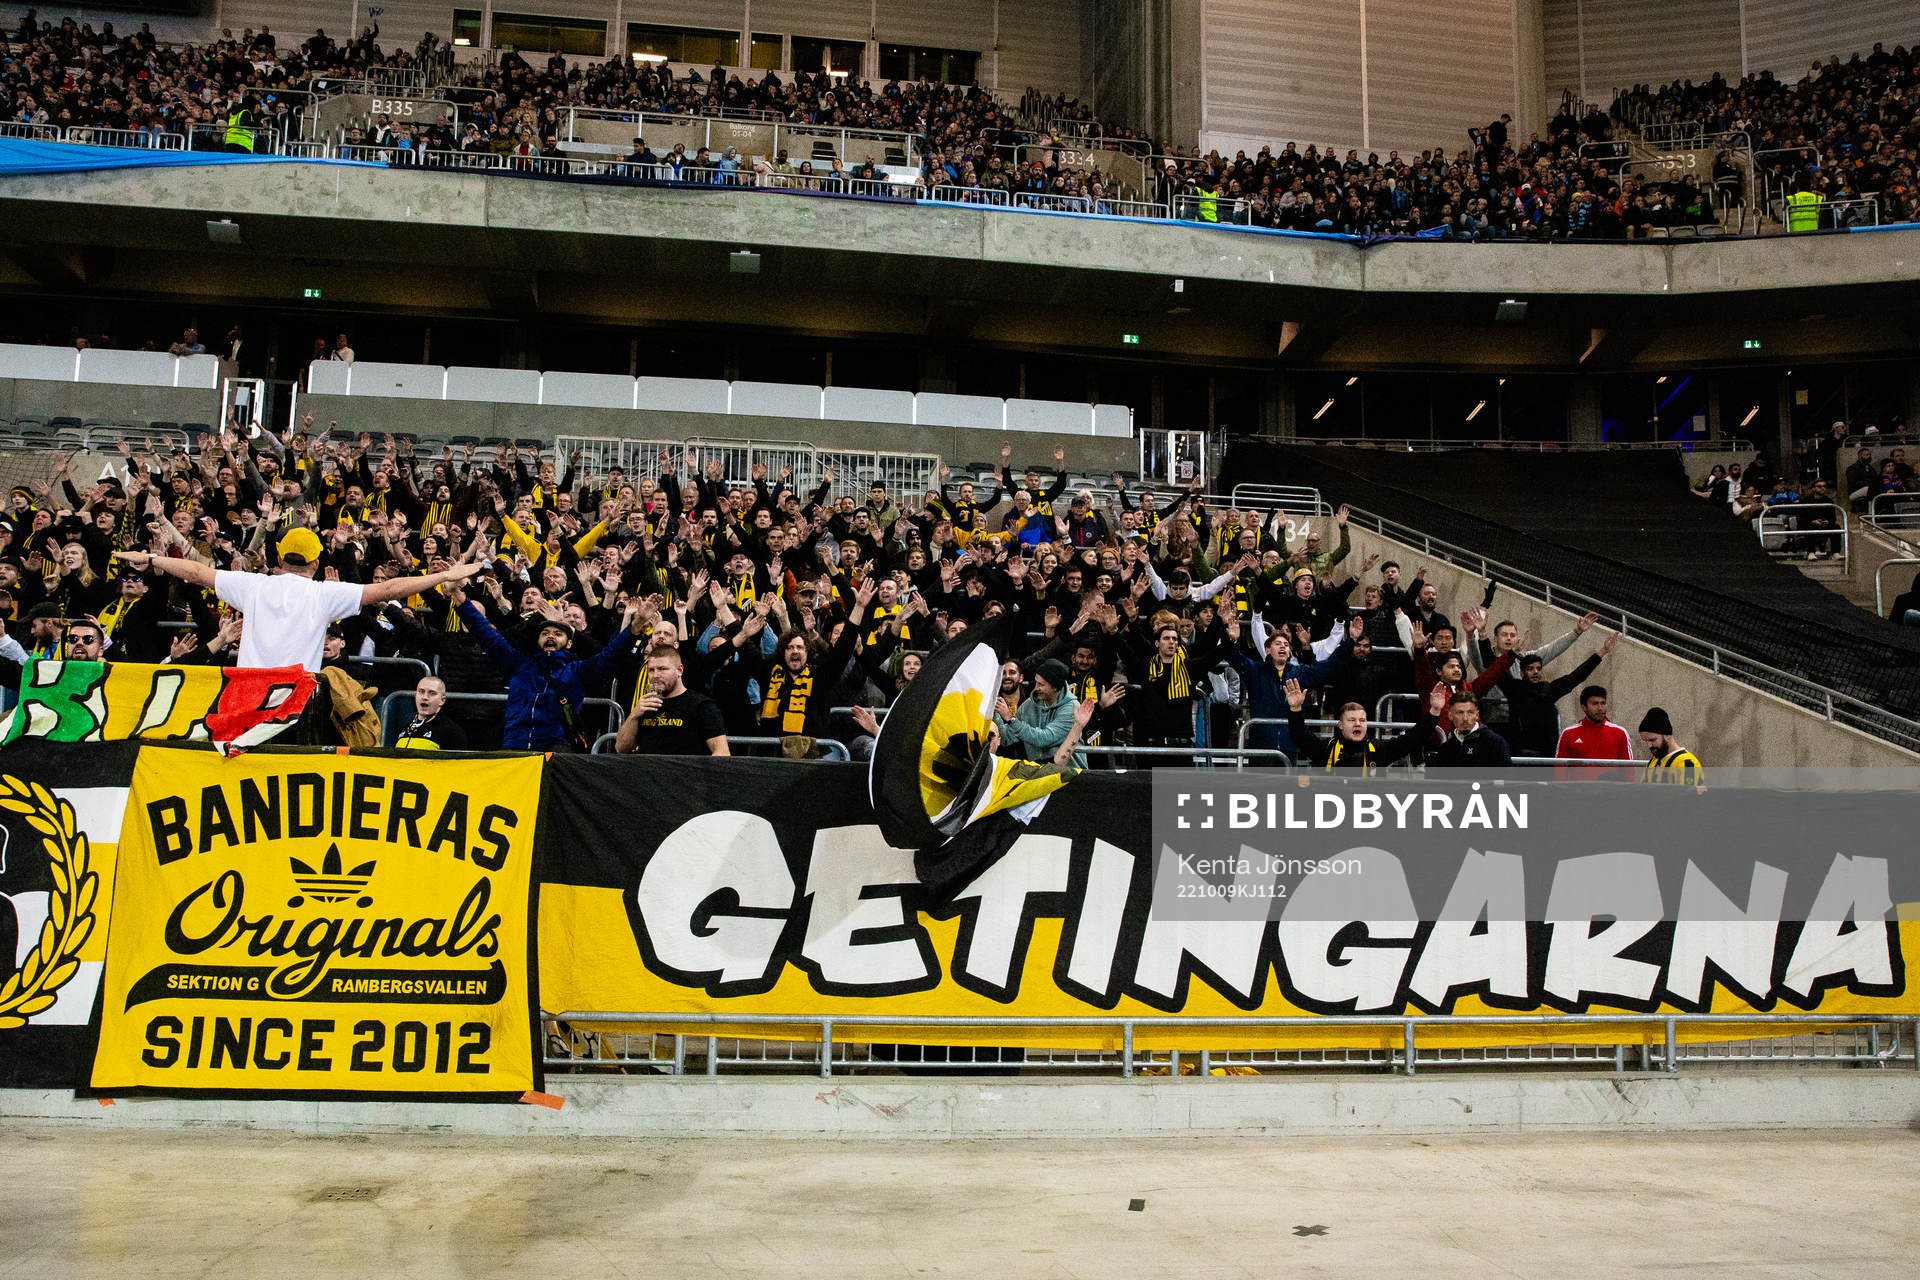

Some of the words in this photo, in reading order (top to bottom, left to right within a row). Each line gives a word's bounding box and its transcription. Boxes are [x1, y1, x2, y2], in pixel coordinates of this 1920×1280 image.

[372, 99, 413, 116] B335
[146, 771, 518, 872] BANDIERAS
[164, 869, 502, 999] Originals
[630, 808, 1900, 1012] GETINGARNA
[167, 974, 242, 992] SEKTION
[248, 976, 260, 991] G
[332, 978, 488, 996] RAMBERGSVALLEN
[141, 1015, 333, 1072] SINCE
[350, 1018, 491, 1074] 2012
